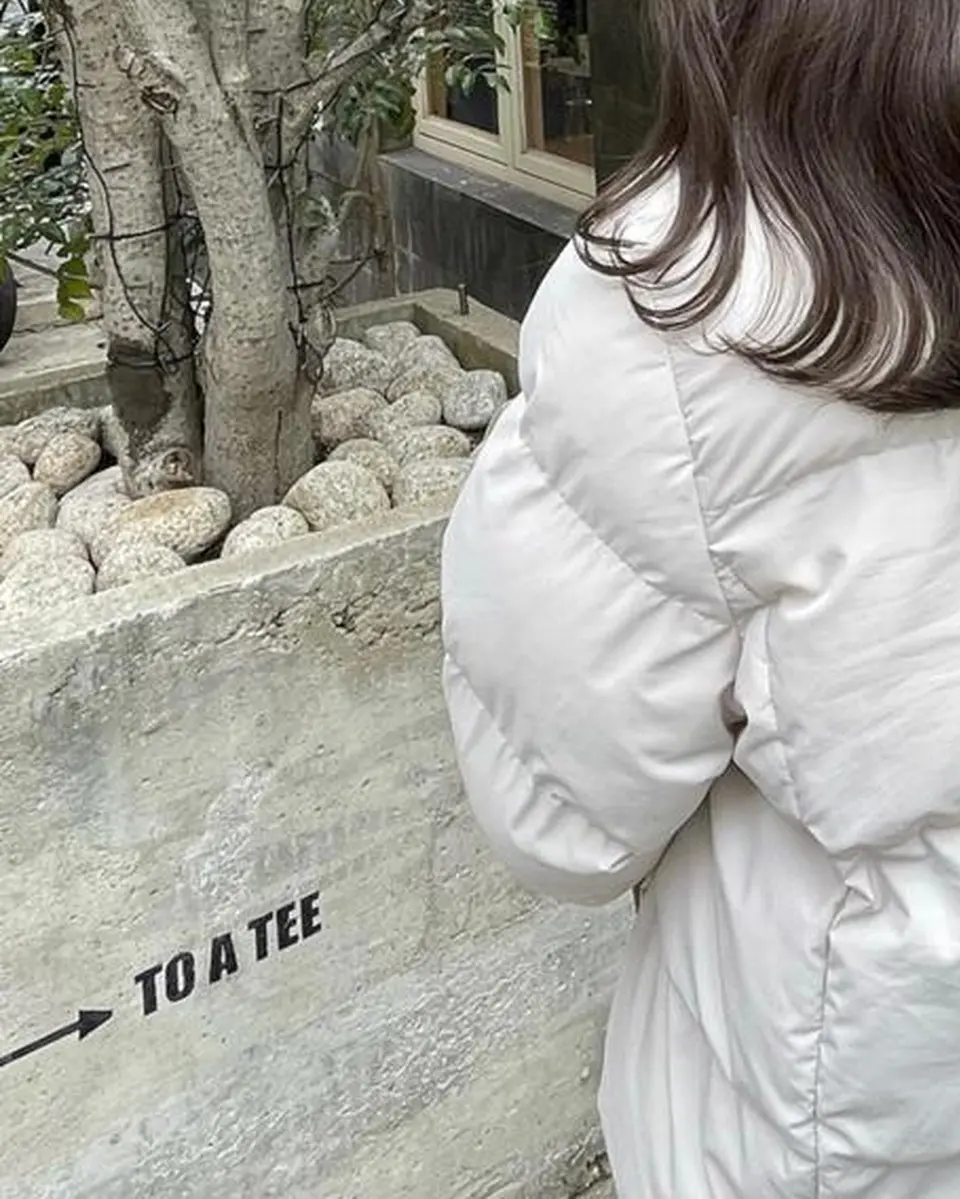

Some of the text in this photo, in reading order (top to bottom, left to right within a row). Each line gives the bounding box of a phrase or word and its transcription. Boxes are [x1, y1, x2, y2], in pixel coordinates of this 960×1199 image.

[134, 890, 322, 1016] TO A TEE
